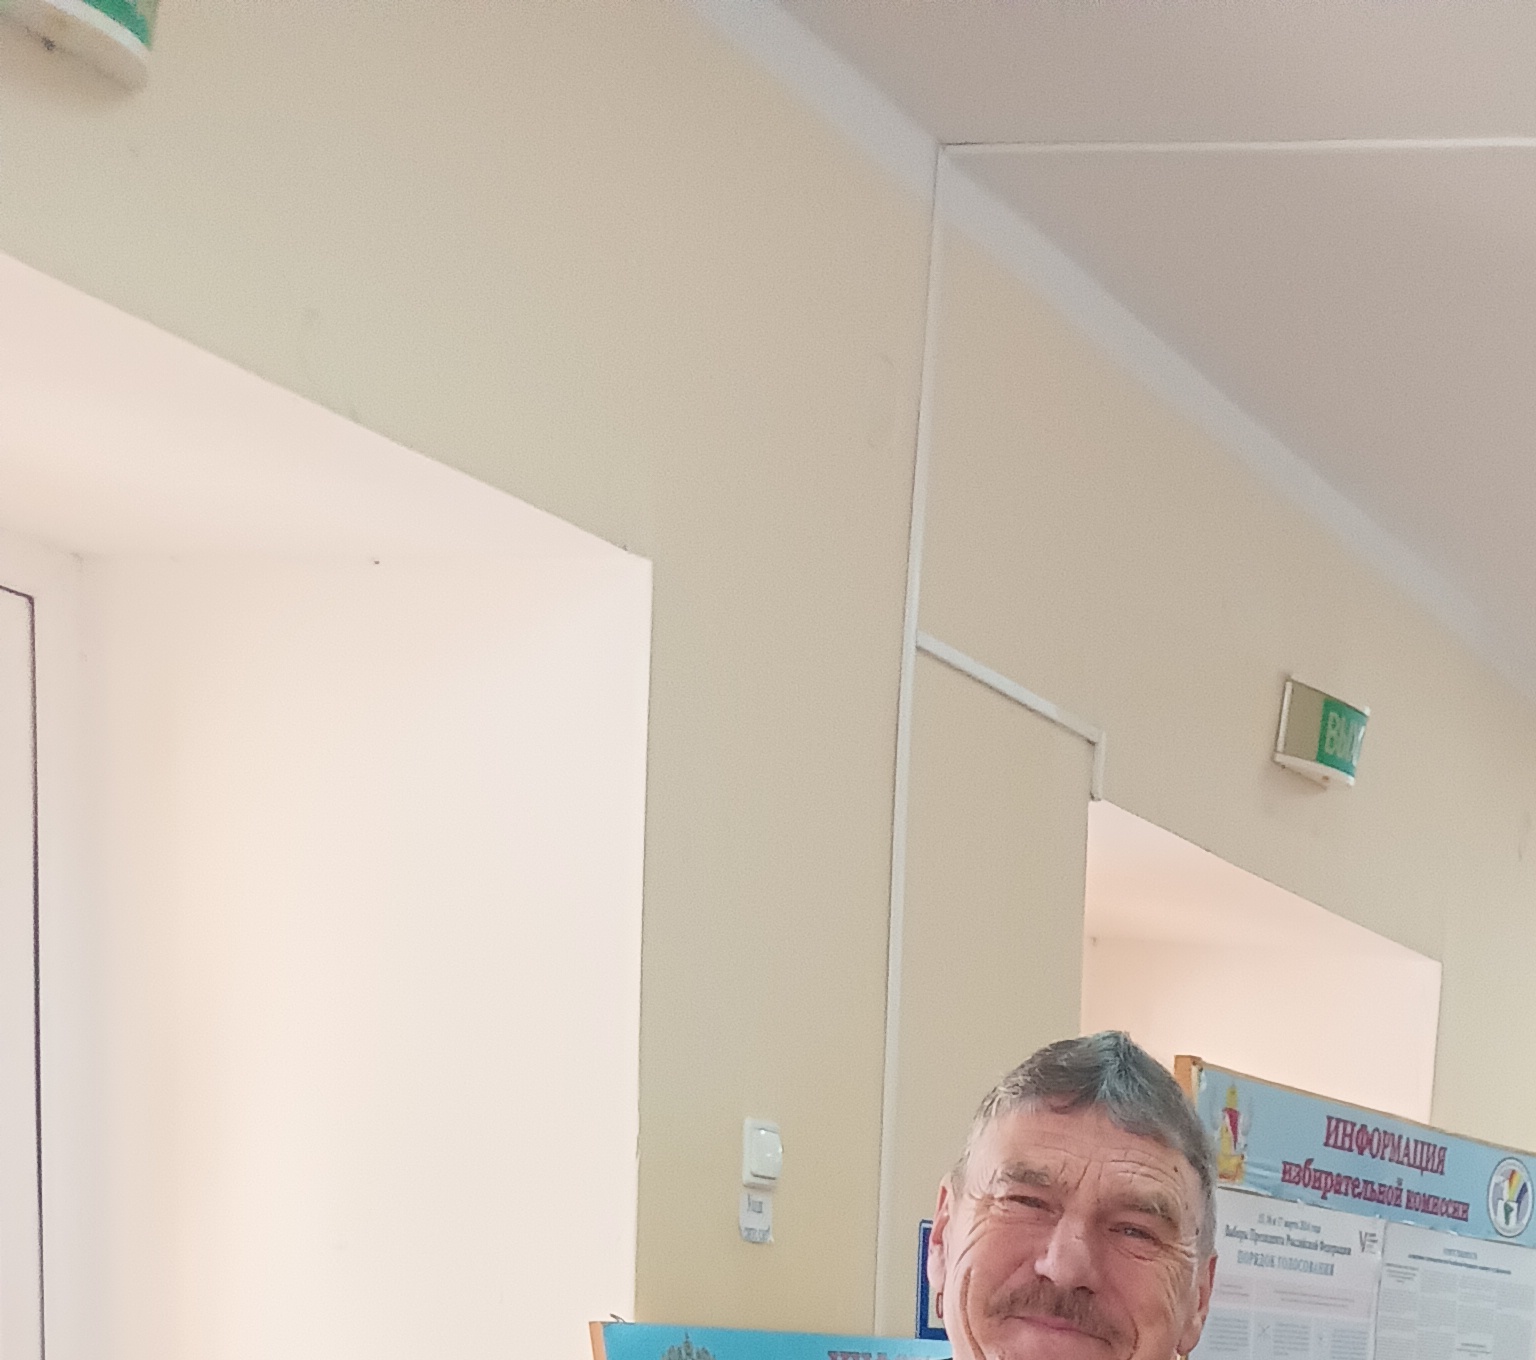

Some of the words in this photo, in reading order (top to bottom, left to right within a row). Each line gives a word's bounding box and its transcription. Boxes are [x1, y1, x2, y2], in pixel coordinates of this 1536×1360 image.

[1323, 1115, 1448, 1177] ИНФОРМАЦИЯ
[1281, 1158, 1403, 1208] избирательной
[1404, 1189, 1471, 1222] комиссии
